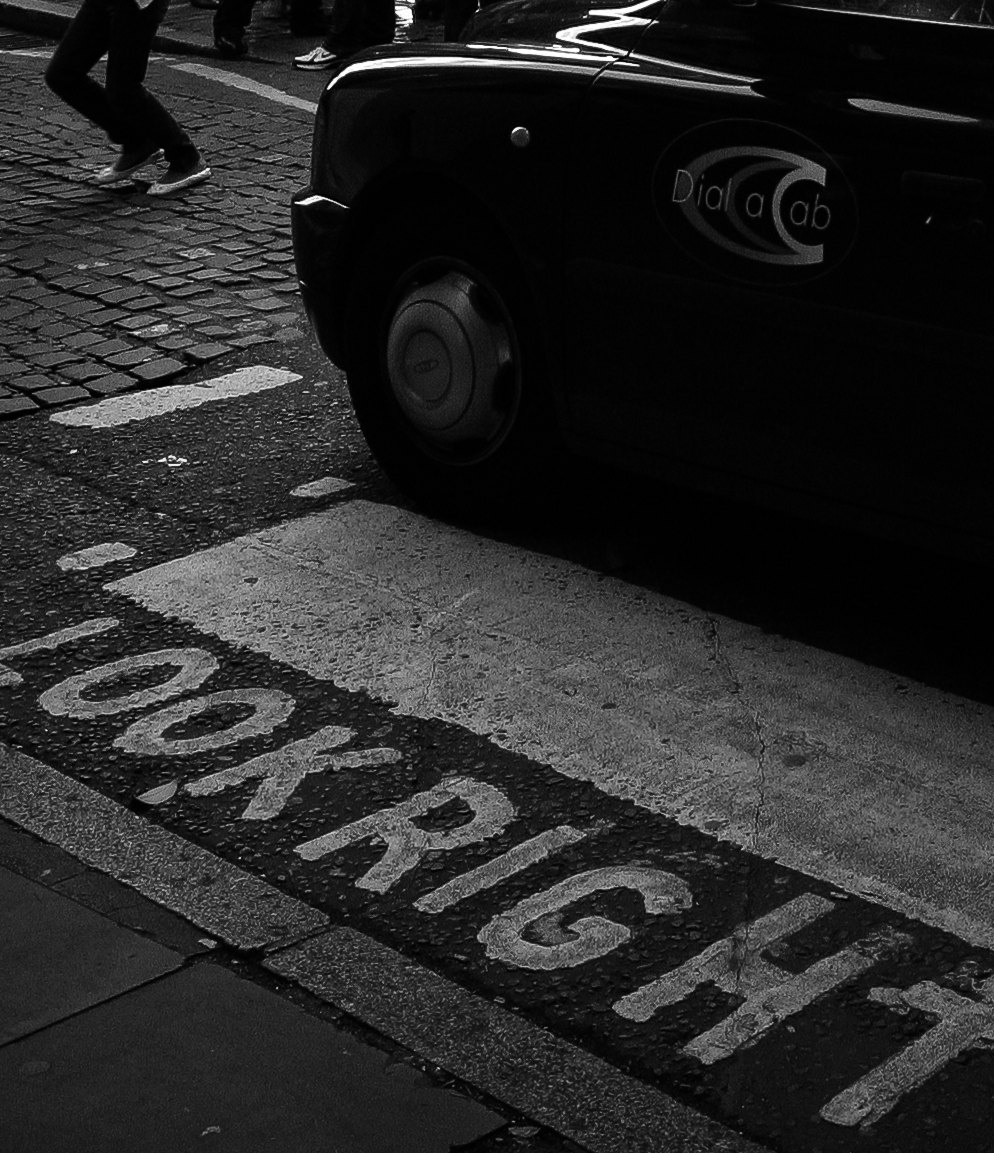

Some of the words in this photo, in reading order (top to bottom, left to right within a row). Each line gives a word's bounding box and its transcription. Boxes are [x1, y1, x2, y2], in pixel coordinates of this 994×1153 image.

[672, 169, 733, 212] Dial
[745, 192, 765, 219] a
[771, 157, 832, 266] Cab
